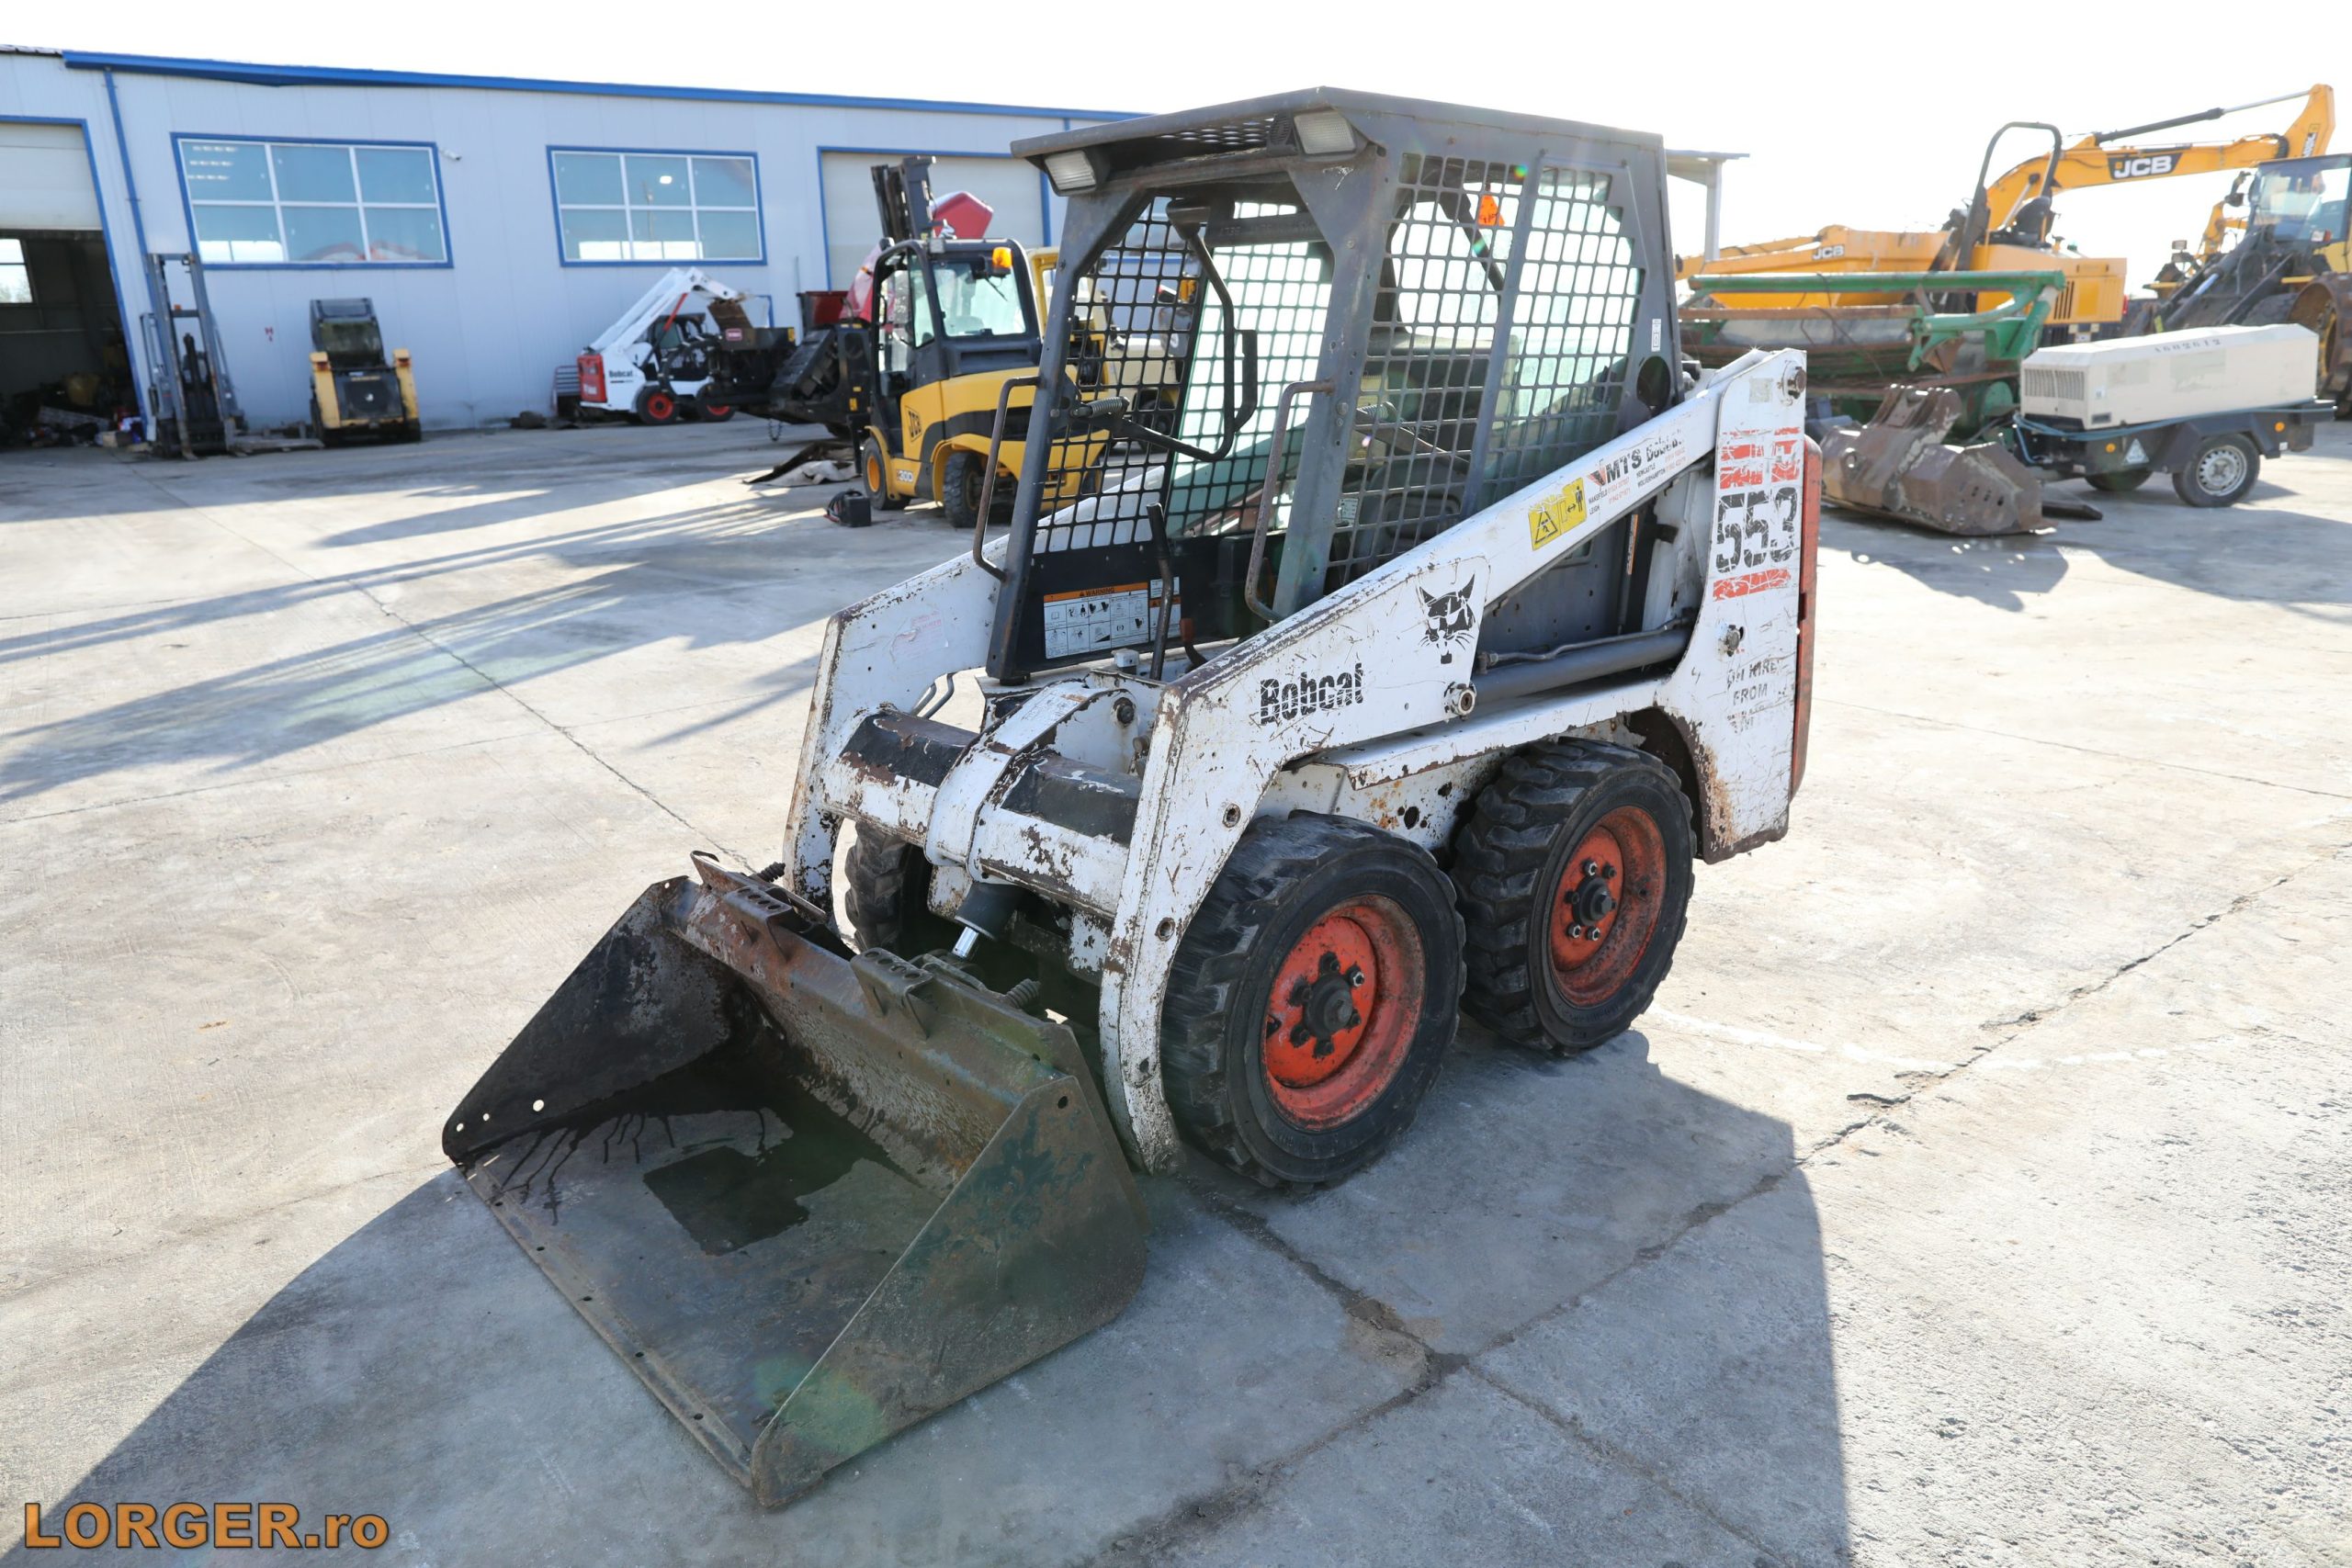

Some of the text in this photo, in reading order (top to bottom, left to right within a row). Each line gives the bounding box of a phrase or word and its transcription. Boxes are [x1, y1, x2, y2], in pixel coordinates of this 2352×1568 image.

[2114, 154, 2173, 178] JCB
[1813, 244, 1845, 260] JCB
[608, 369, 633, 378] Bobcat
[908, 410, 922, 438] JCB
[1605, 447, 1643, 484] MTS
[1715, 486, 1798, 574] 553
[1085, 587, 1115, 597] WARNING
[1260, 662, 1364, 726] Bobcat
[1733, 682, 1768, 706] FROM
